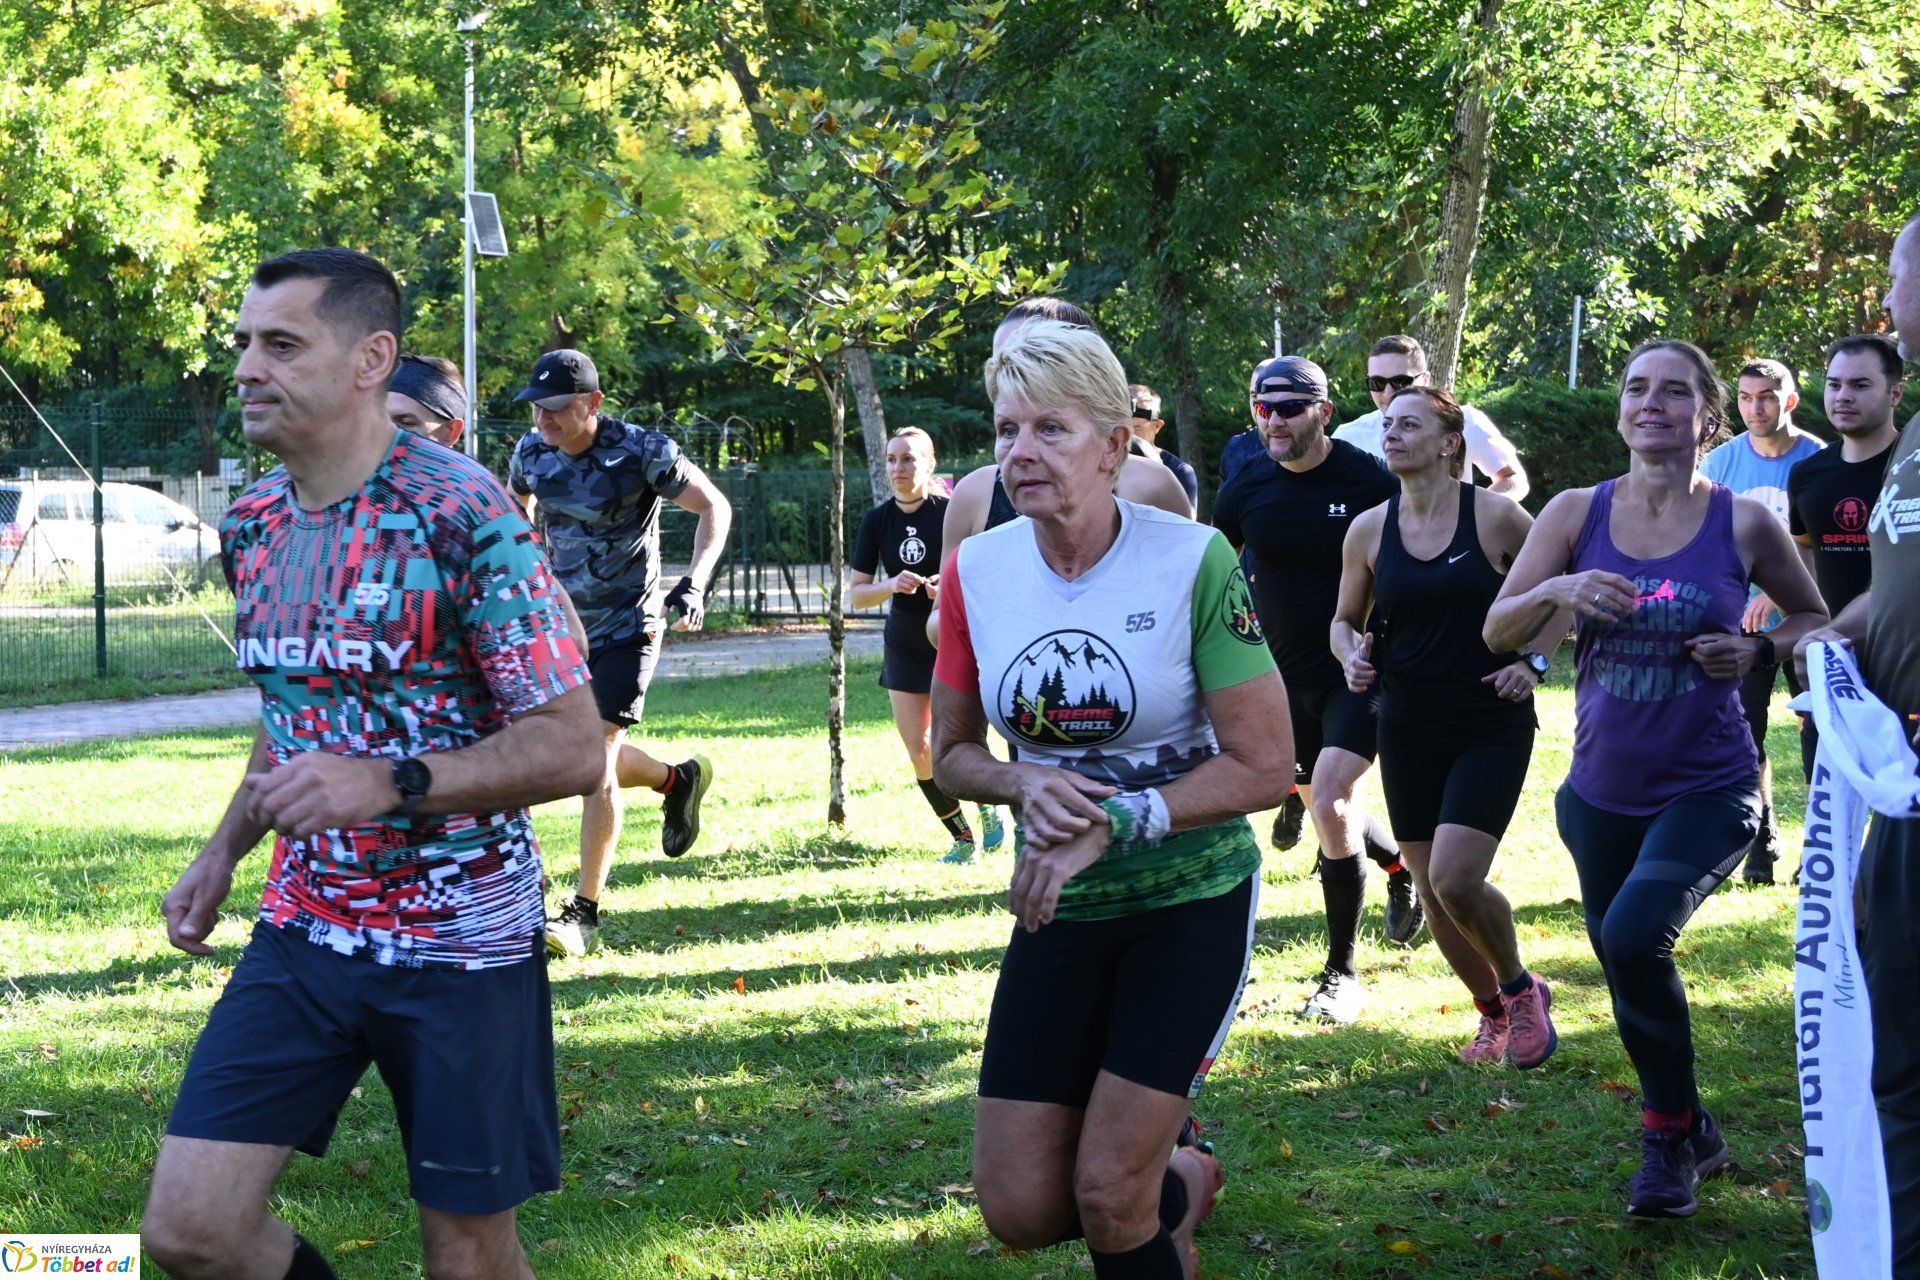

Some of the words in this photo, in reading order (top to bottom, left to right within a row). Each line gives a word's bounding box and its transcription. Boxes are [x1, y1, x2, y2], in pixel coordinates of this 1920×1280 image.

[354, 583, 390, 606] 575
[1125, 611, 1156, 633] 575
[1058, 721, 1115, 731] TRAIL
